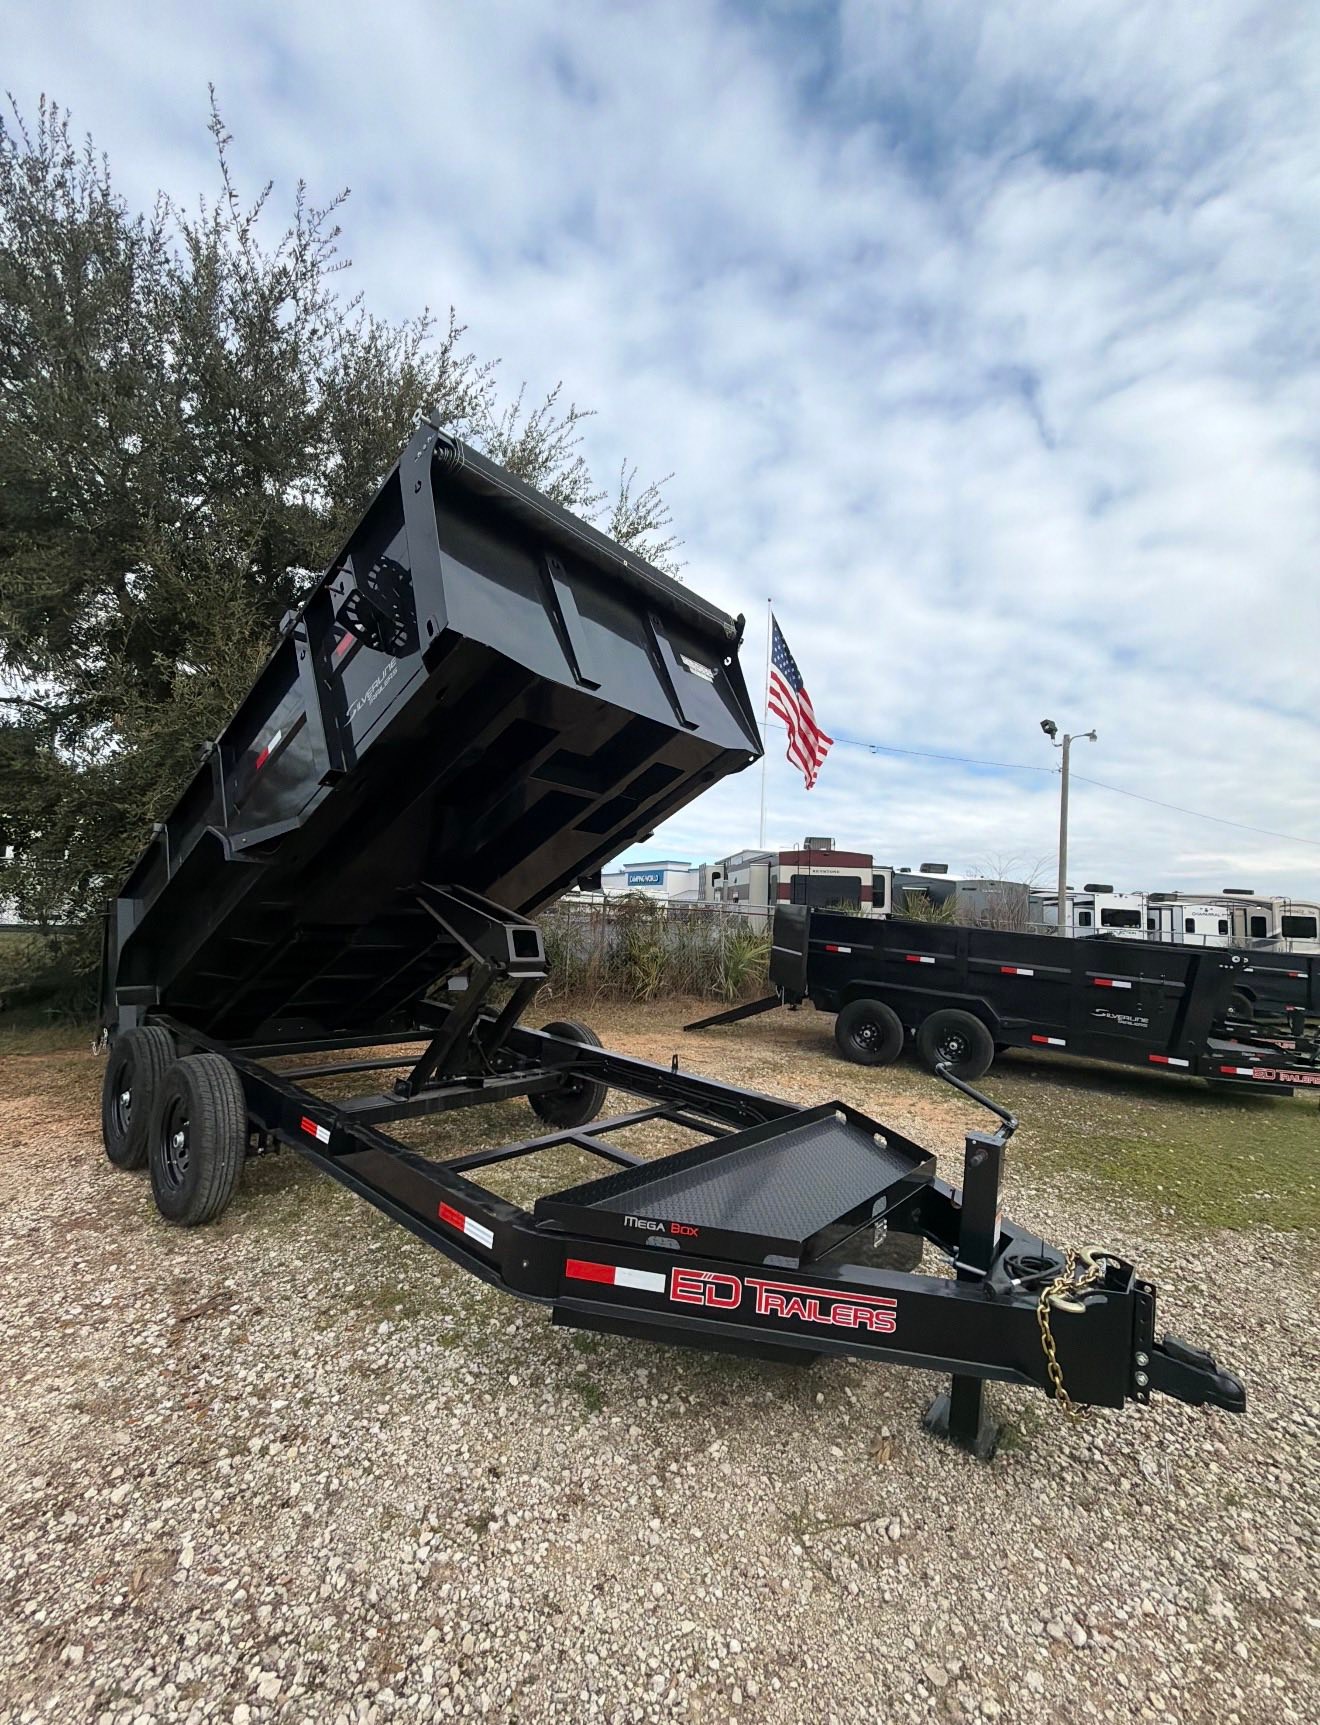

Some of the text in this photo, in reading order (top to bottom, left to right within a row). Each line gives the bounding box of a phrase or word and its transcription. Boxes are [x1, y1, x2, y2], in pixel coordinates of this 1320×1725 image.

[624, 1216, 665, 1233] MEGA
[670, 1267, 898, 1334] ED TRAILERS
